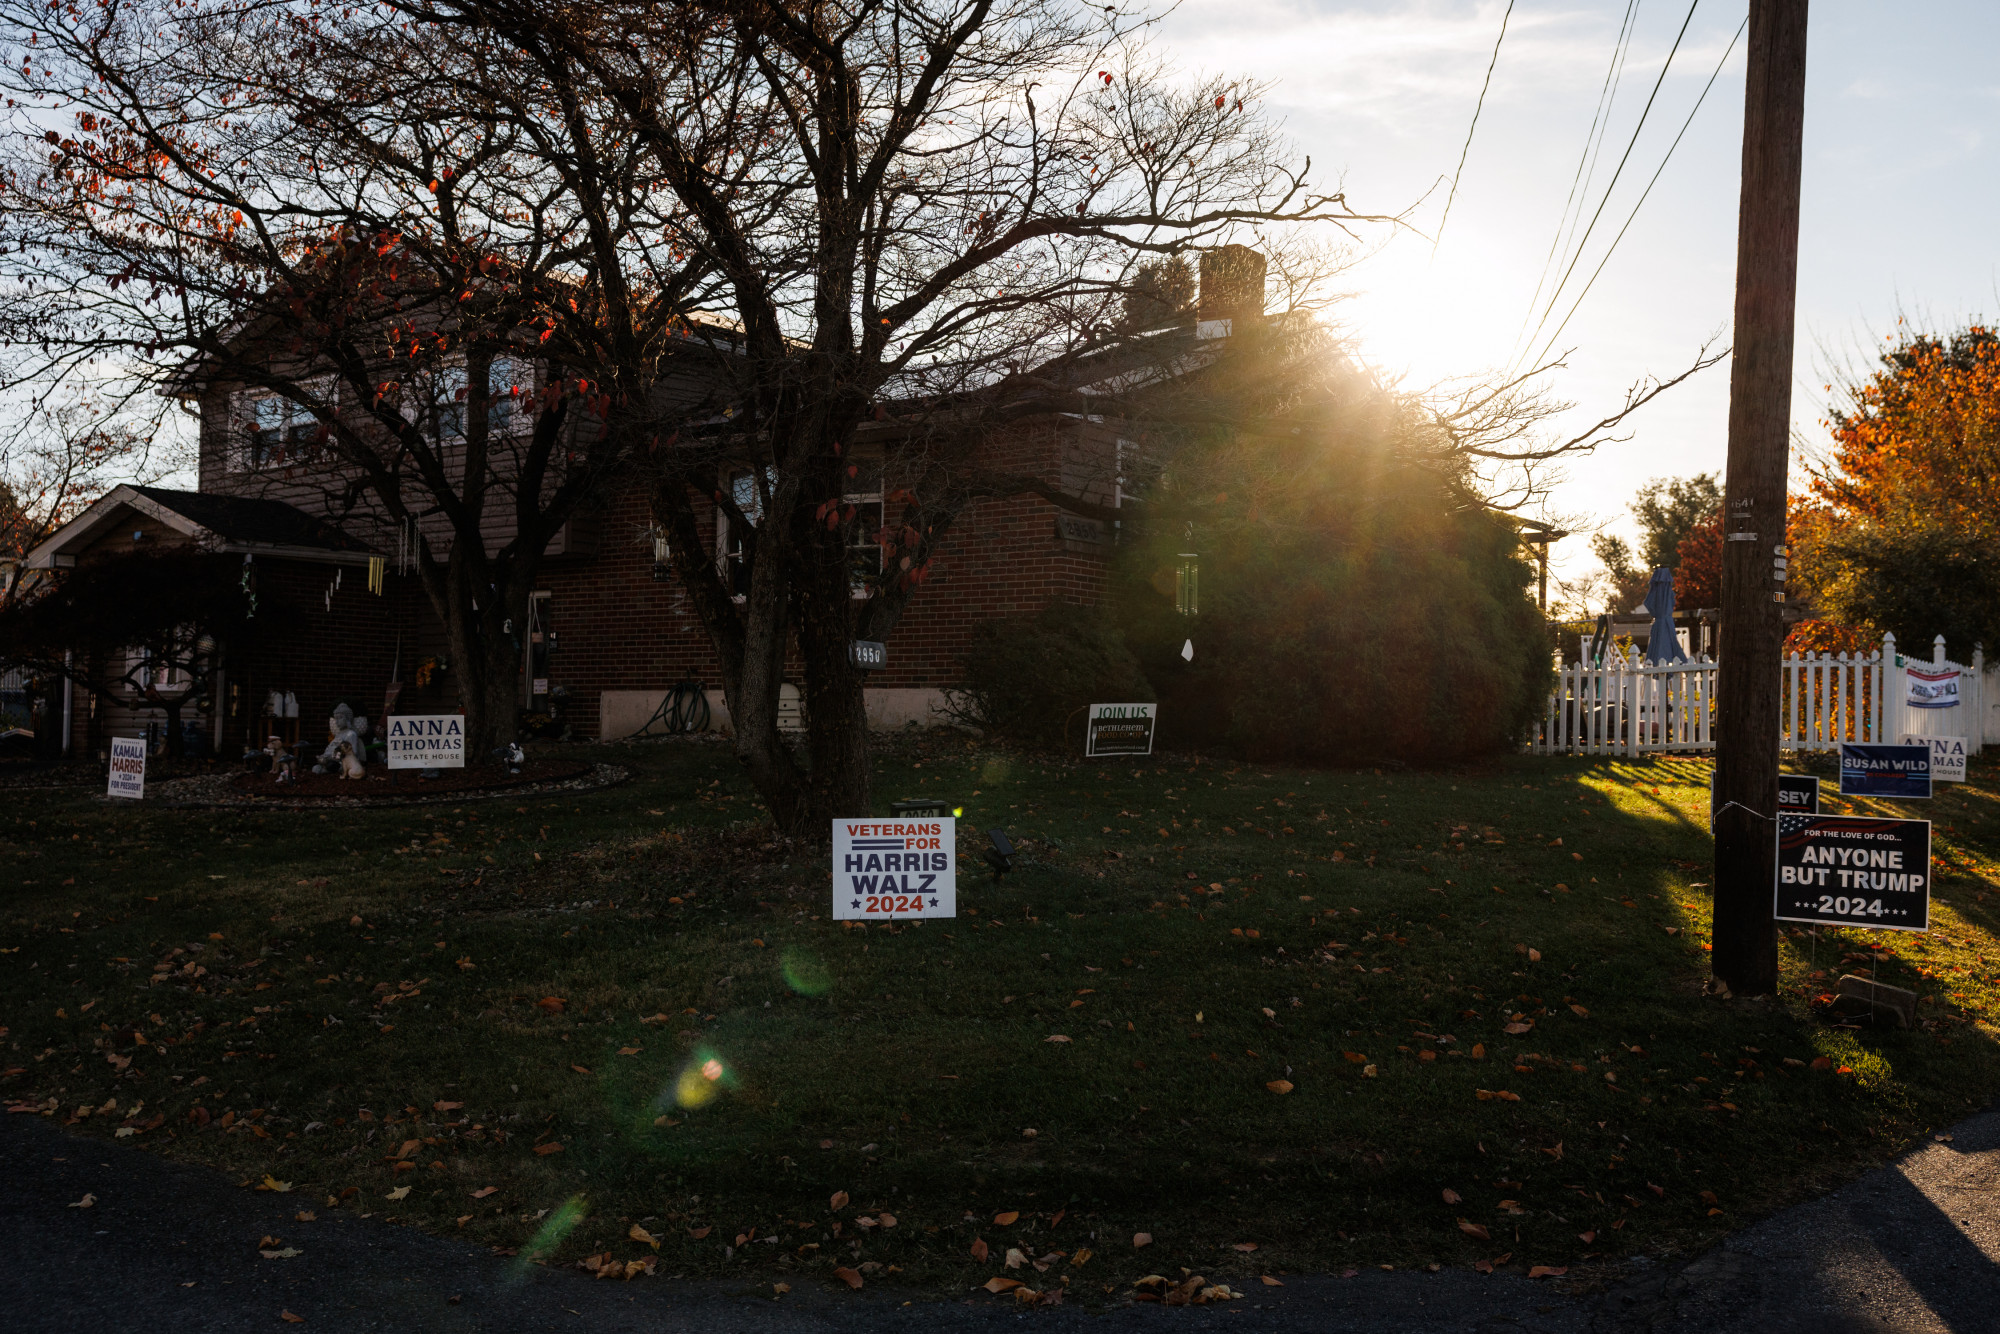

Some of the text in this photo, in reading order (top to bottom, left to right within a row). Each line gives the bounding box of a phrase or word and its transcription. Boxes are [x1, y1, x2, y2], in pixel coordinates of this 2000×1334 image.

[856, 646, 880, 663] 2950
[1097, 706, 1147, 719] JOIN US
[390, 720, 462, 736] ANNA
[113, 744, 143, 759] KAMALA
[390, 738, 462, 750] THOMAS
[112, 757, 143, 774] HARRIS
[1844, 758, 1928, 771] SUSAN WILD
[1933, 756, 1964, 767] MAS
[111, 780, 141, 791] FOR PRESIDENT
[1779, 790, 1811, 805] SEY
[847, 824, 941, 836] VETERANS
[1822, 830, 1839, 838] THE
[1841, 831, 1862, 839] LOVE
[906, 838, 941, 850] FOR
[845, 852, 948, 872] HARRIS
[1801, 845, 1903, 870] ANYONE
[851, 874, 937, 894] WALZ
[1781, 866, 1925, 893] BUT TRUMP
[865, 895, 924, 913] 2024
[1818, 895, 1884, 917] 2024
